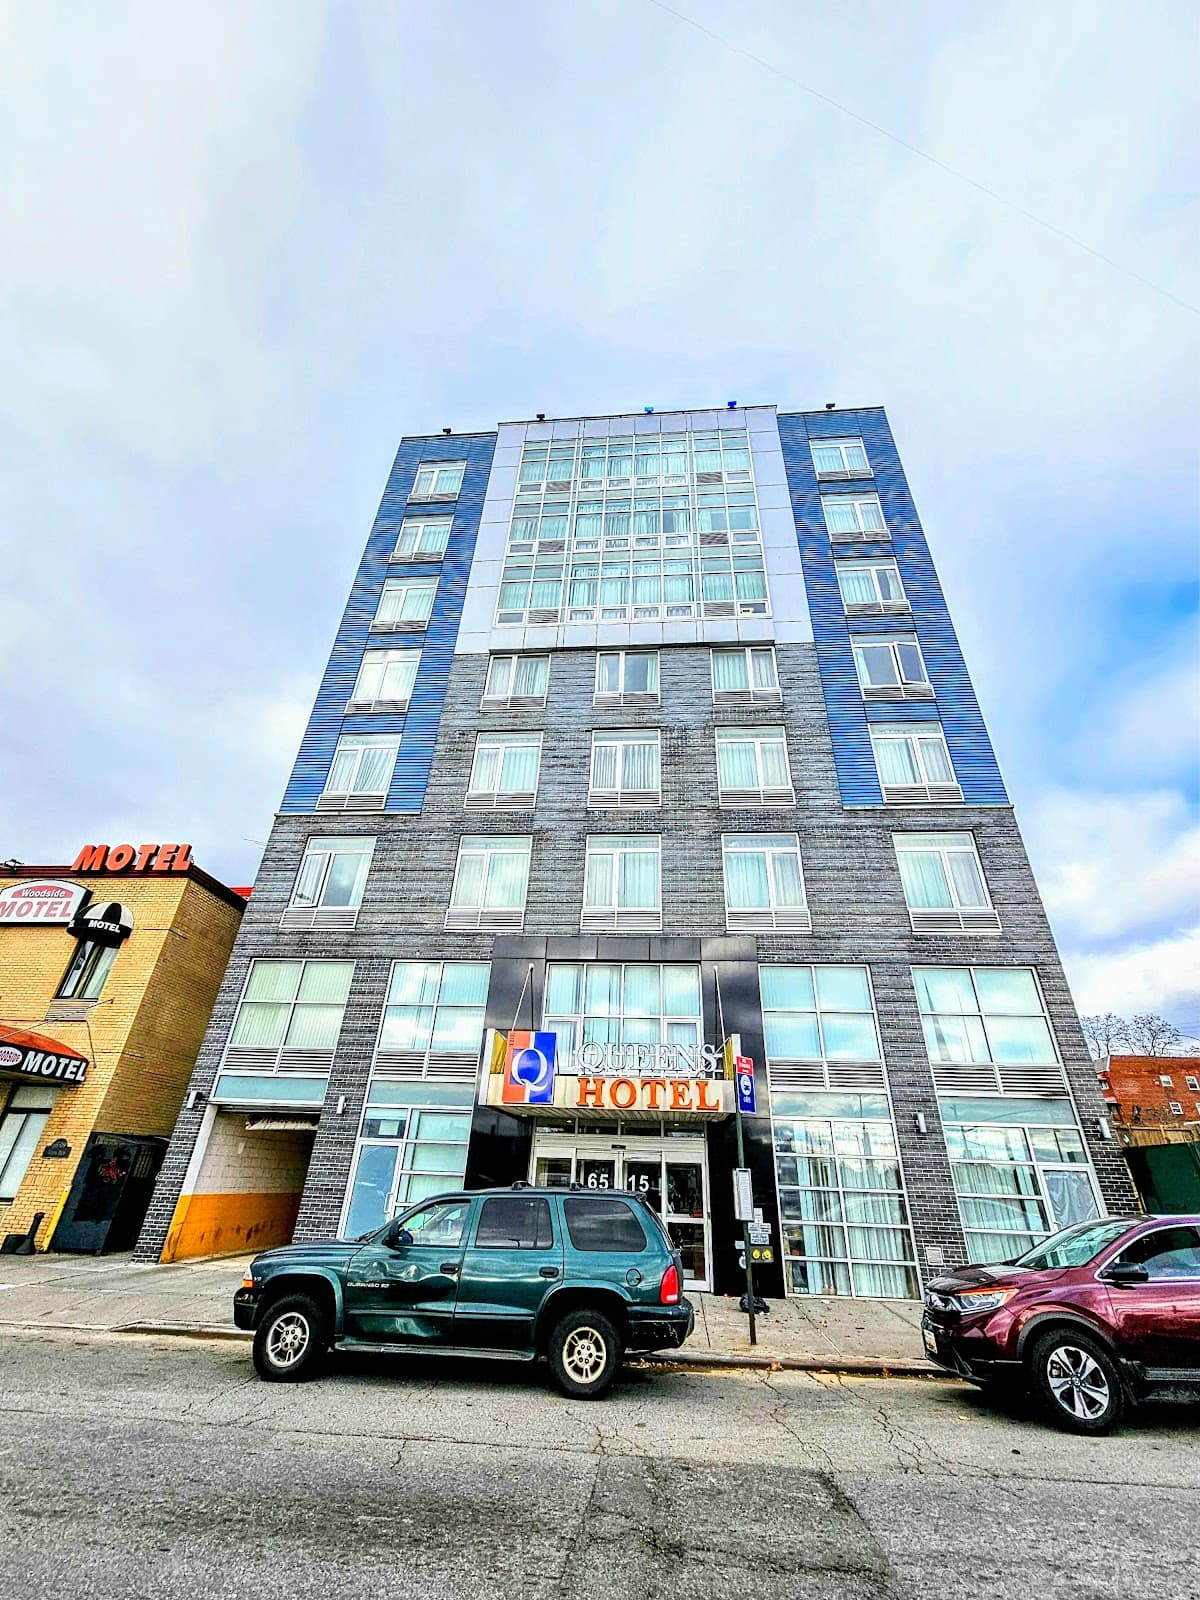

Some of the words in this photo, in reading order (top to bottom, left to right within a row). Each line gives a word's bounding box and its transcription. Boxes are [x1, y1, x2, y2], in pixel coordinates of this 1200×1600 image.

[71, 843, 192, 871] MOTEL
[22, 888, 66, 898] Woodside
[0, 901, 72, 918] MOTEL
[88, 919, 121, 933] MOTEL
[21, 1050, 87, 1082] MOTEL
[511, 1048, 548, 1092] Q
[577, 1041, 718, 1073] QUEENS
[576, 1077, 720, 1111] HOTEL
[587, 1172, 609, 1189] 65
[628, 1174, 650, 1192] 15
